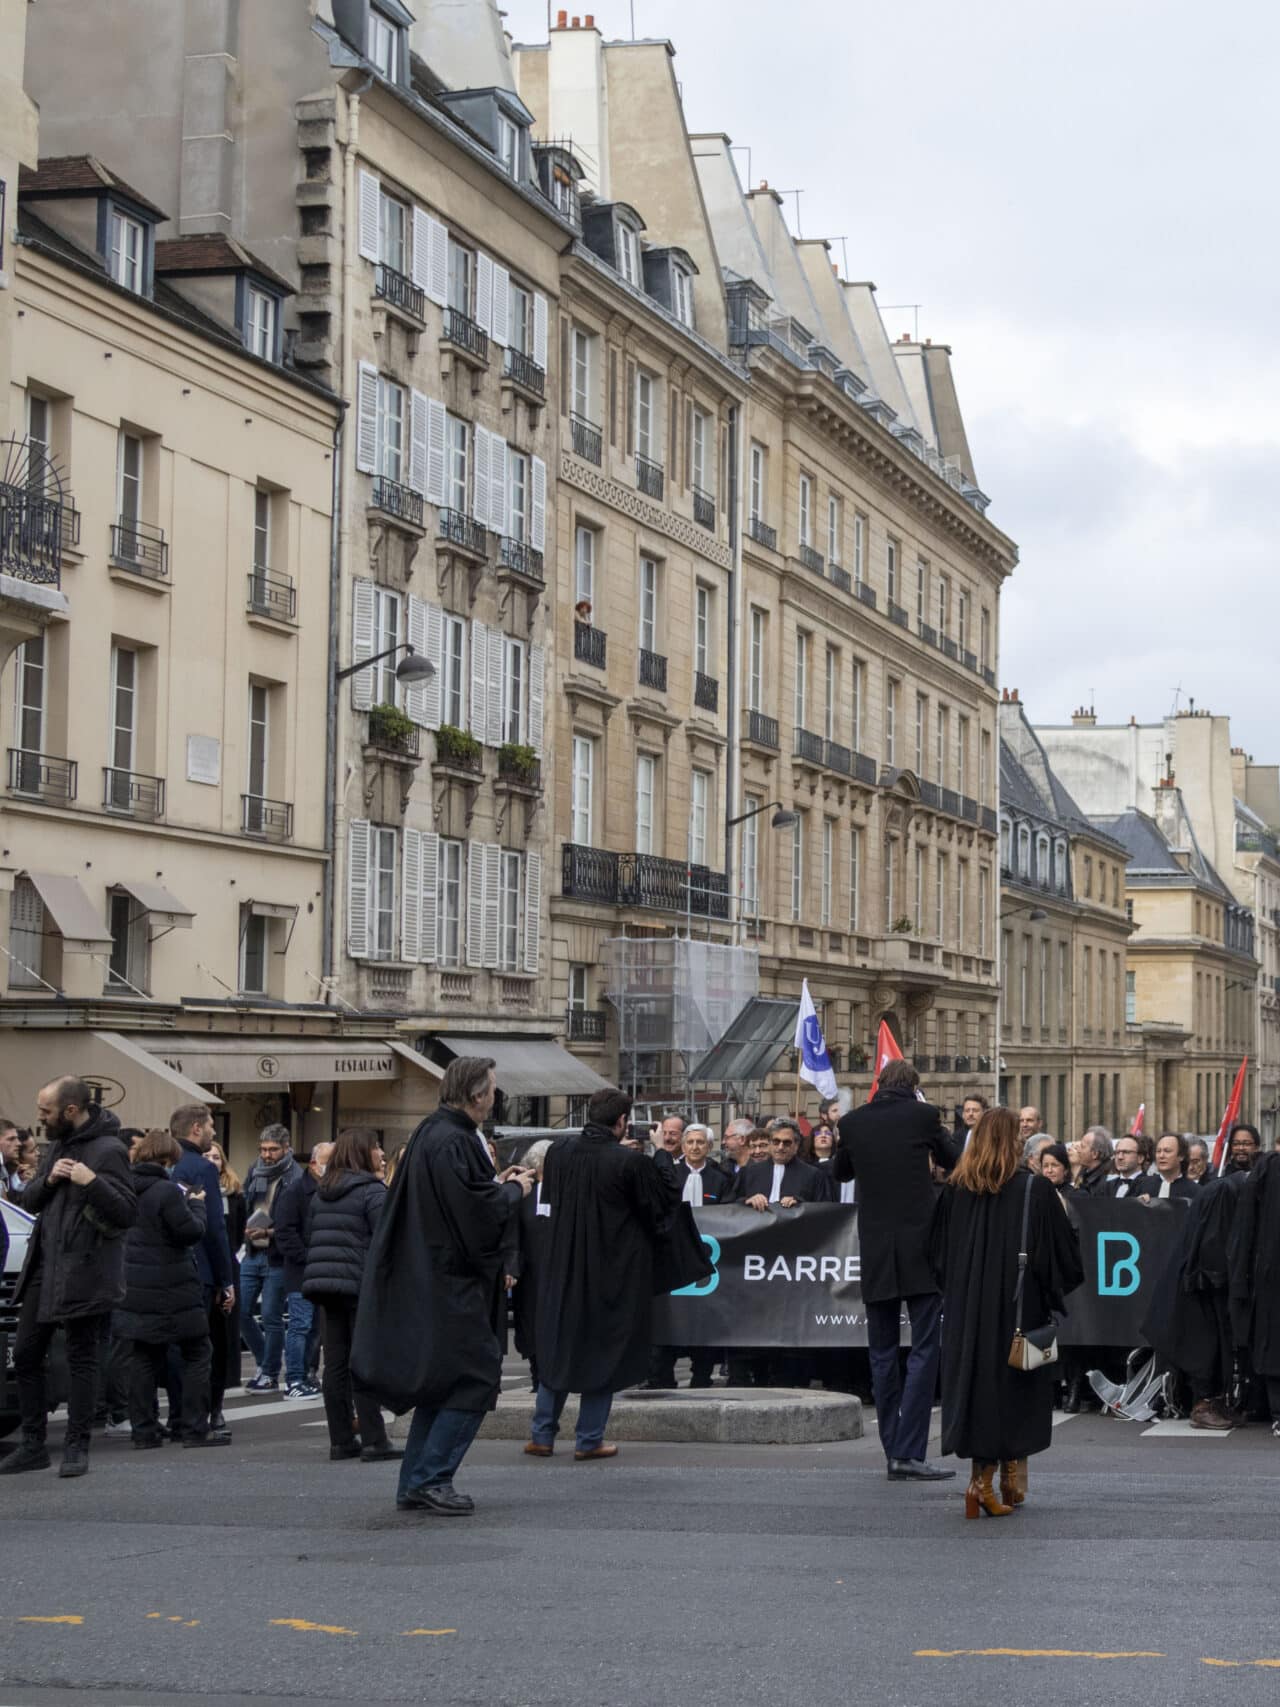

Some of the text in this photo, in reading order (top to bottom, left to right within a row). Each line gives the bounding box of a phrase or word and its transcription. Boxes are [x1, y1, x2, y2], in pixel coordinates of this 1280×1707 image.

[335, 1059, 393, 1072] RESTAURANT
[744, 1255, 861, 1281] BARRE
[1098, 1231, 1141, 1296] B
